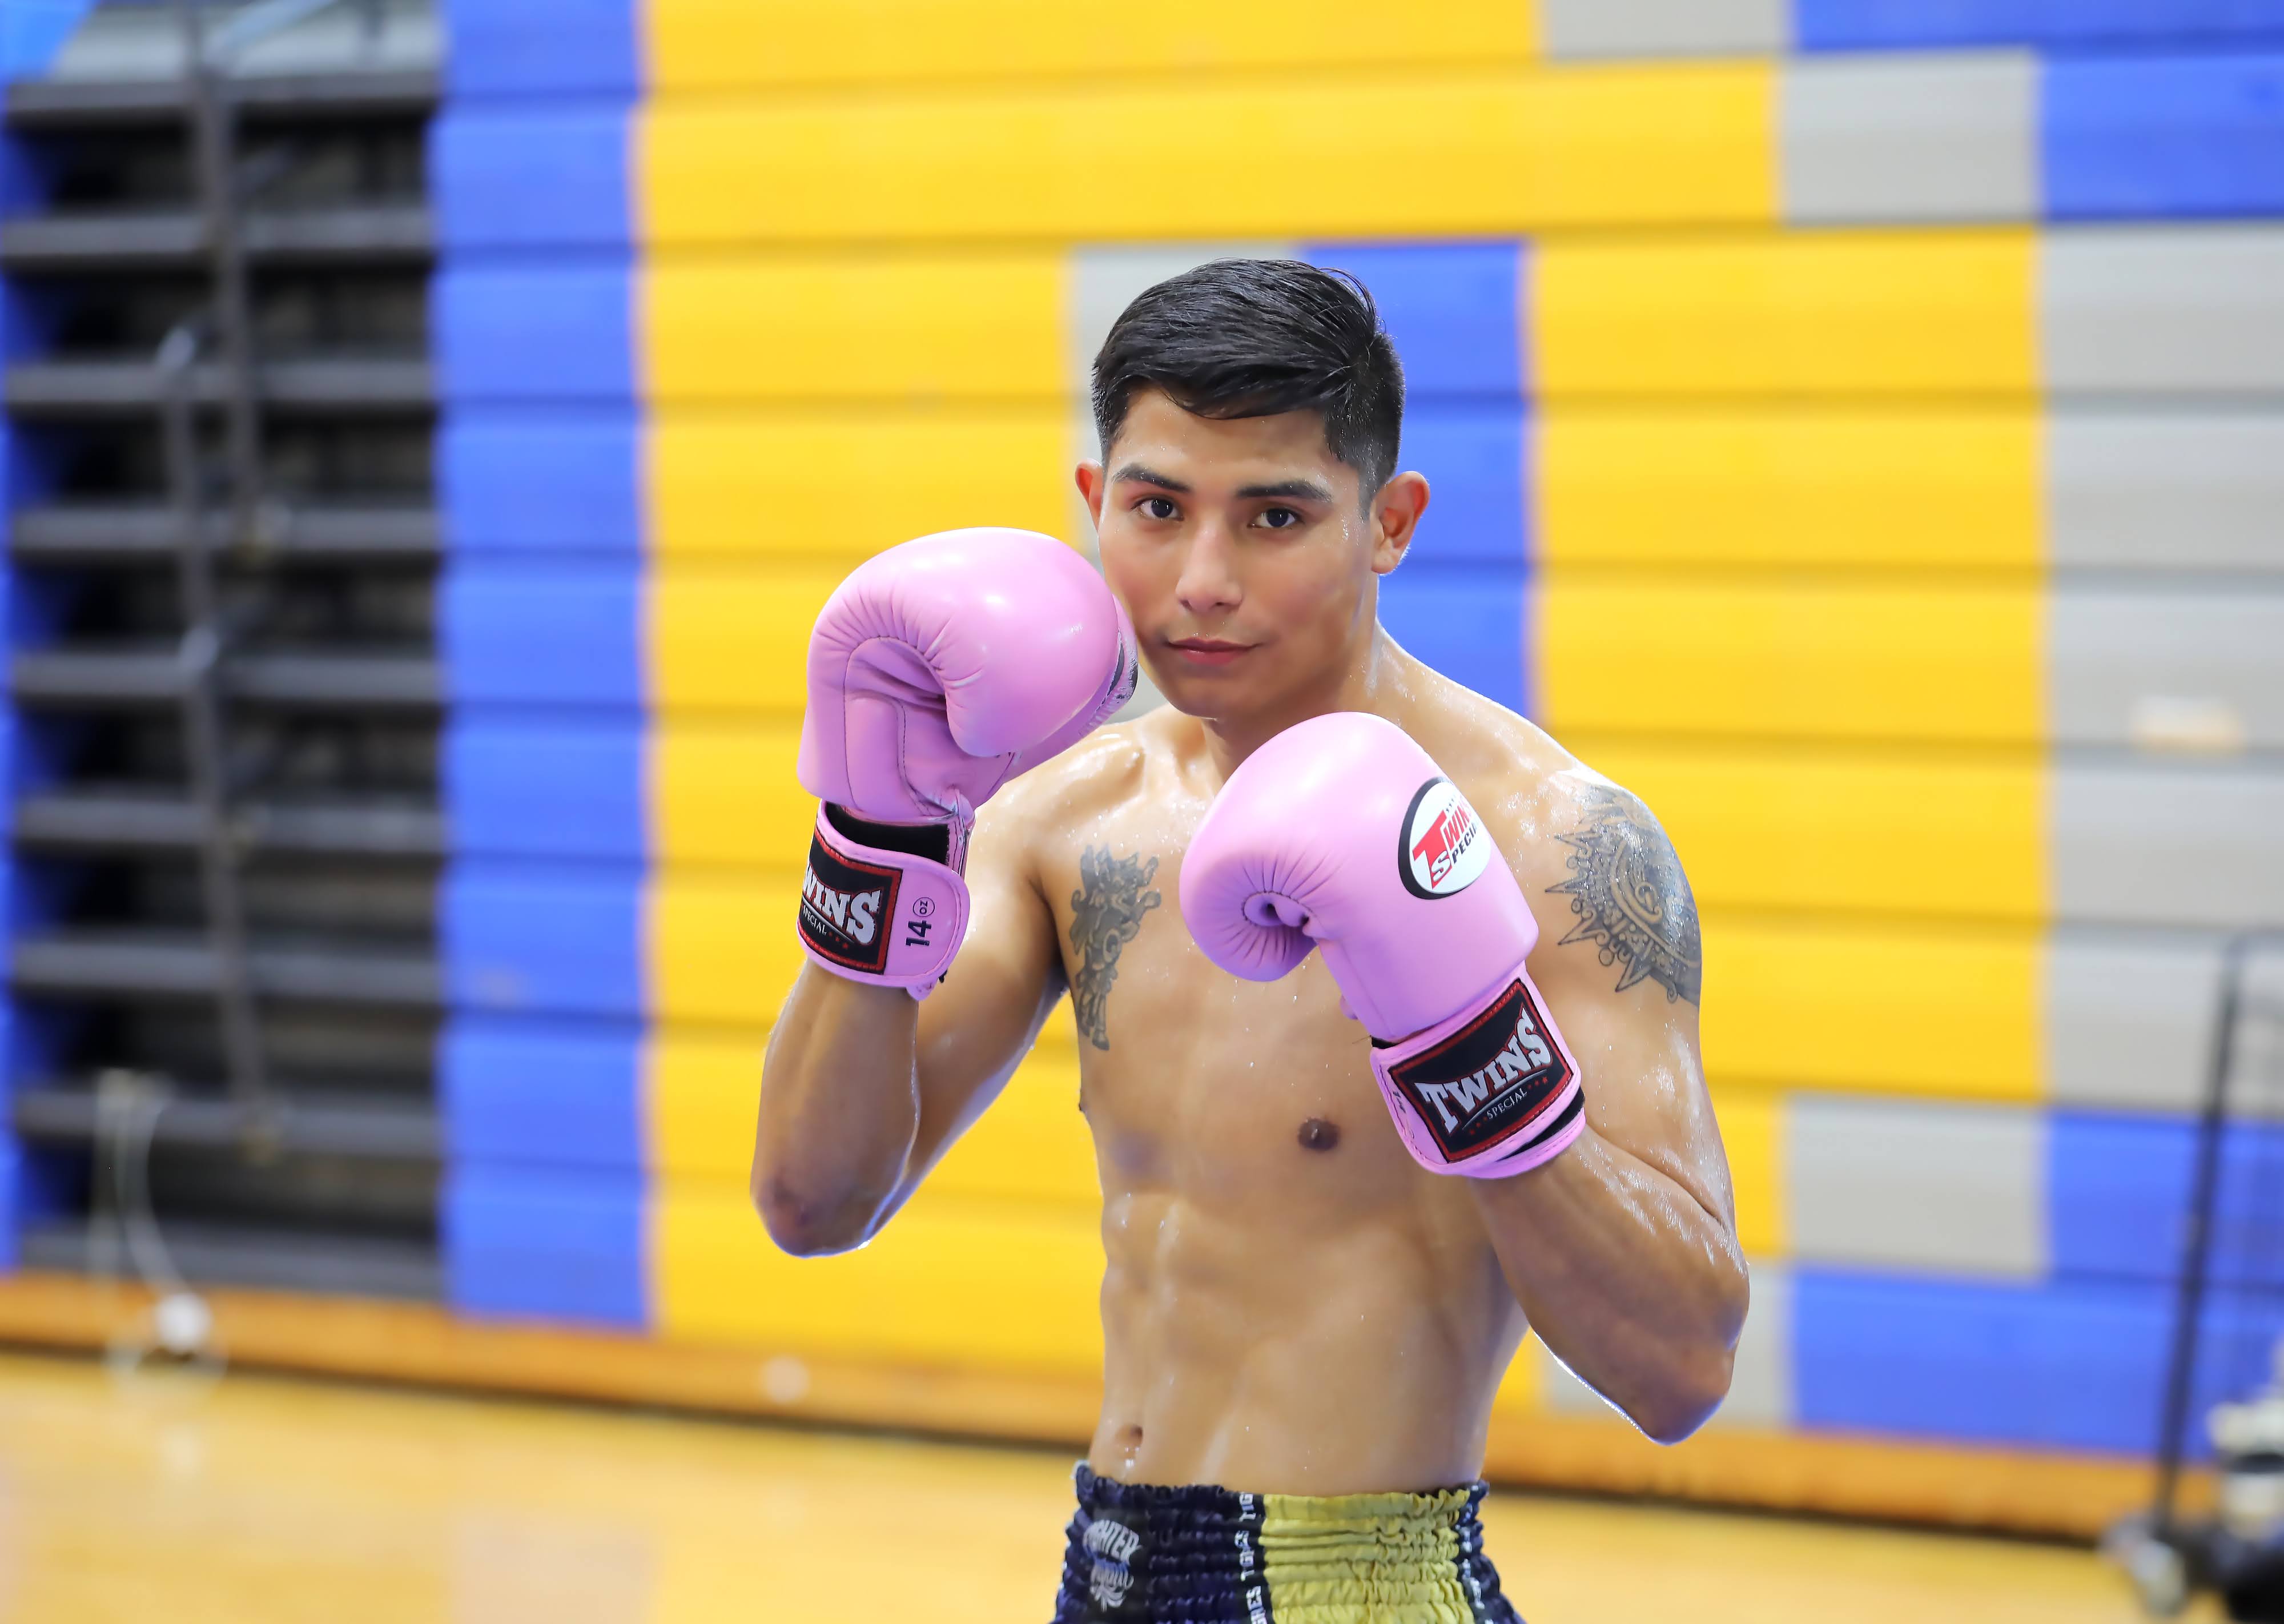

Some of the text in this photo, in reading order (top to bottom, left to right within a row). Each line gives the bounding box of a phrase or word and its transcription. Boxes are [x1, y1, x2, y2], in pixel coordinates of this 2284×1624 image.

[803, 864, 881, 945] WINS
[803, 904, 827, 936] SPECIAL
[906, 920, 932, 947] 14
[1414, 1007, 1553, 1135] TWINS
[1487, 1087, 1527, 1120] SPECIAL
